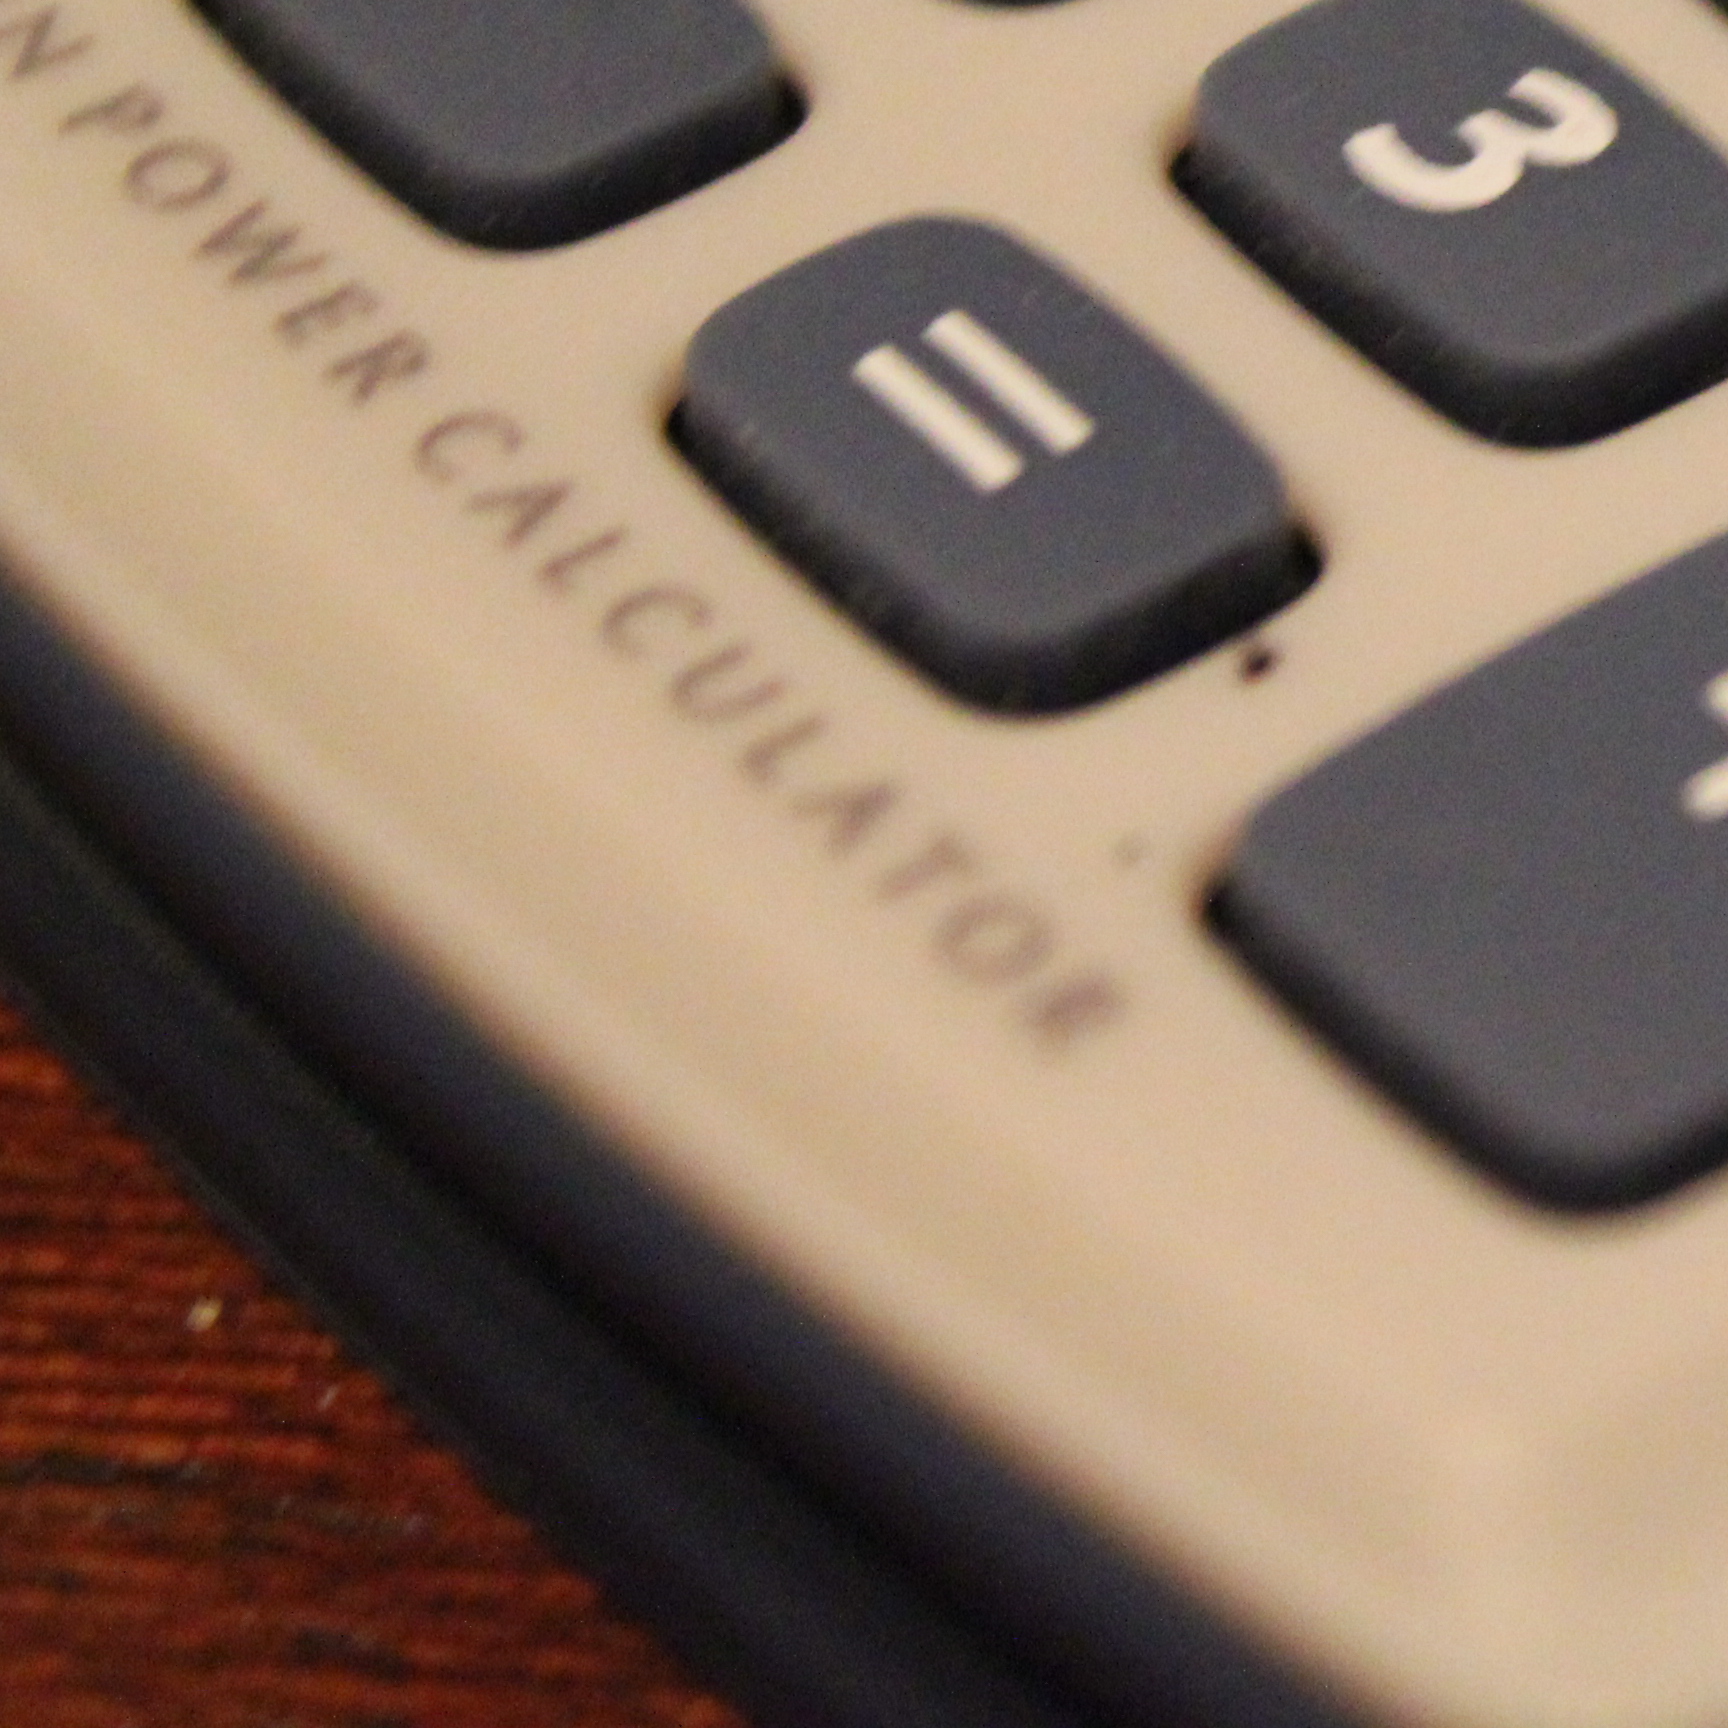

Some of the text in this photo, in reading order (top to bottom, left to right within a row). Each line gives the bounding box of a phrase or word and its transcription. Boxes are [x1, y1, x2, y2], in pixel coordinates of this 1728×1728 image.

[1340, 66, 1618, 214] 3
[57, 84, 430, 406] POWER
[414, 410, 1128, 1048] CALCULATOR
